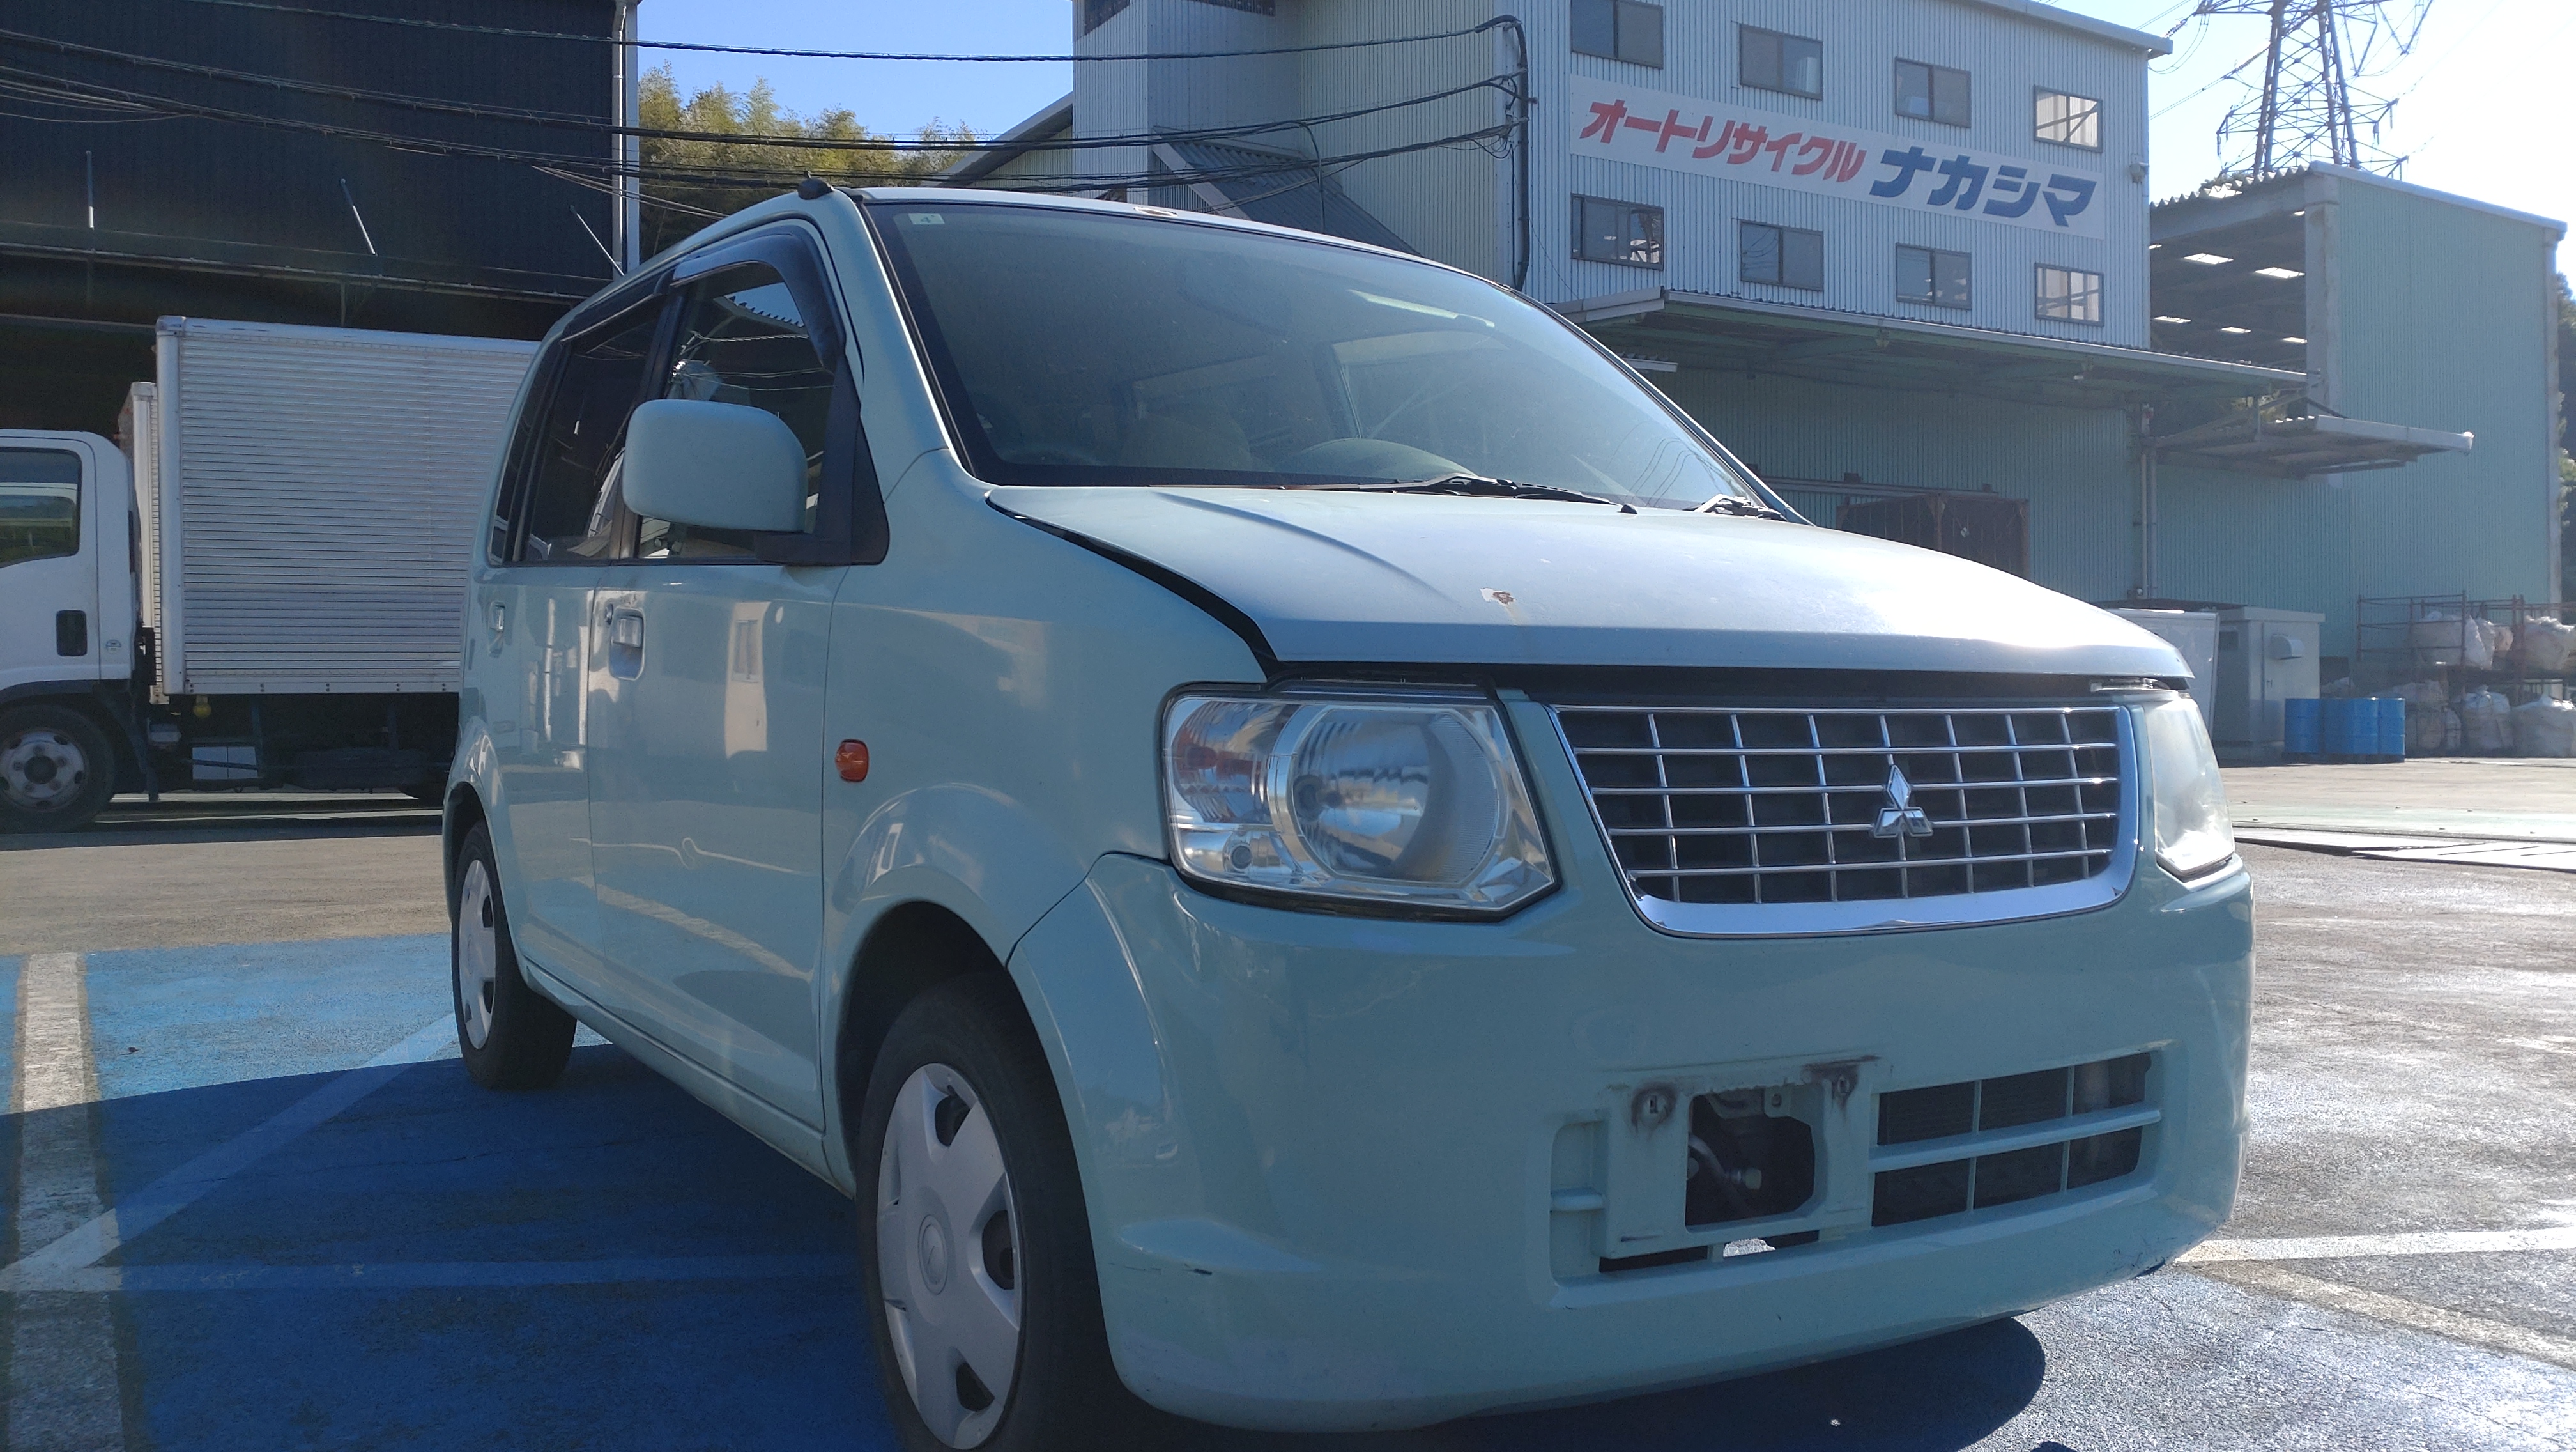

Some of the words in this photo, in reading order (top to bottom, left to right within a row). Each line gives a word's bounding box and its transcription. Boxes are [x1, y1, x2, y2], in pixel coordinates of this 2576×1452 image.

[1580, 100, 1866, 182] オートリサイクル
[1869, 147, 2097, 227] ナカシマ
